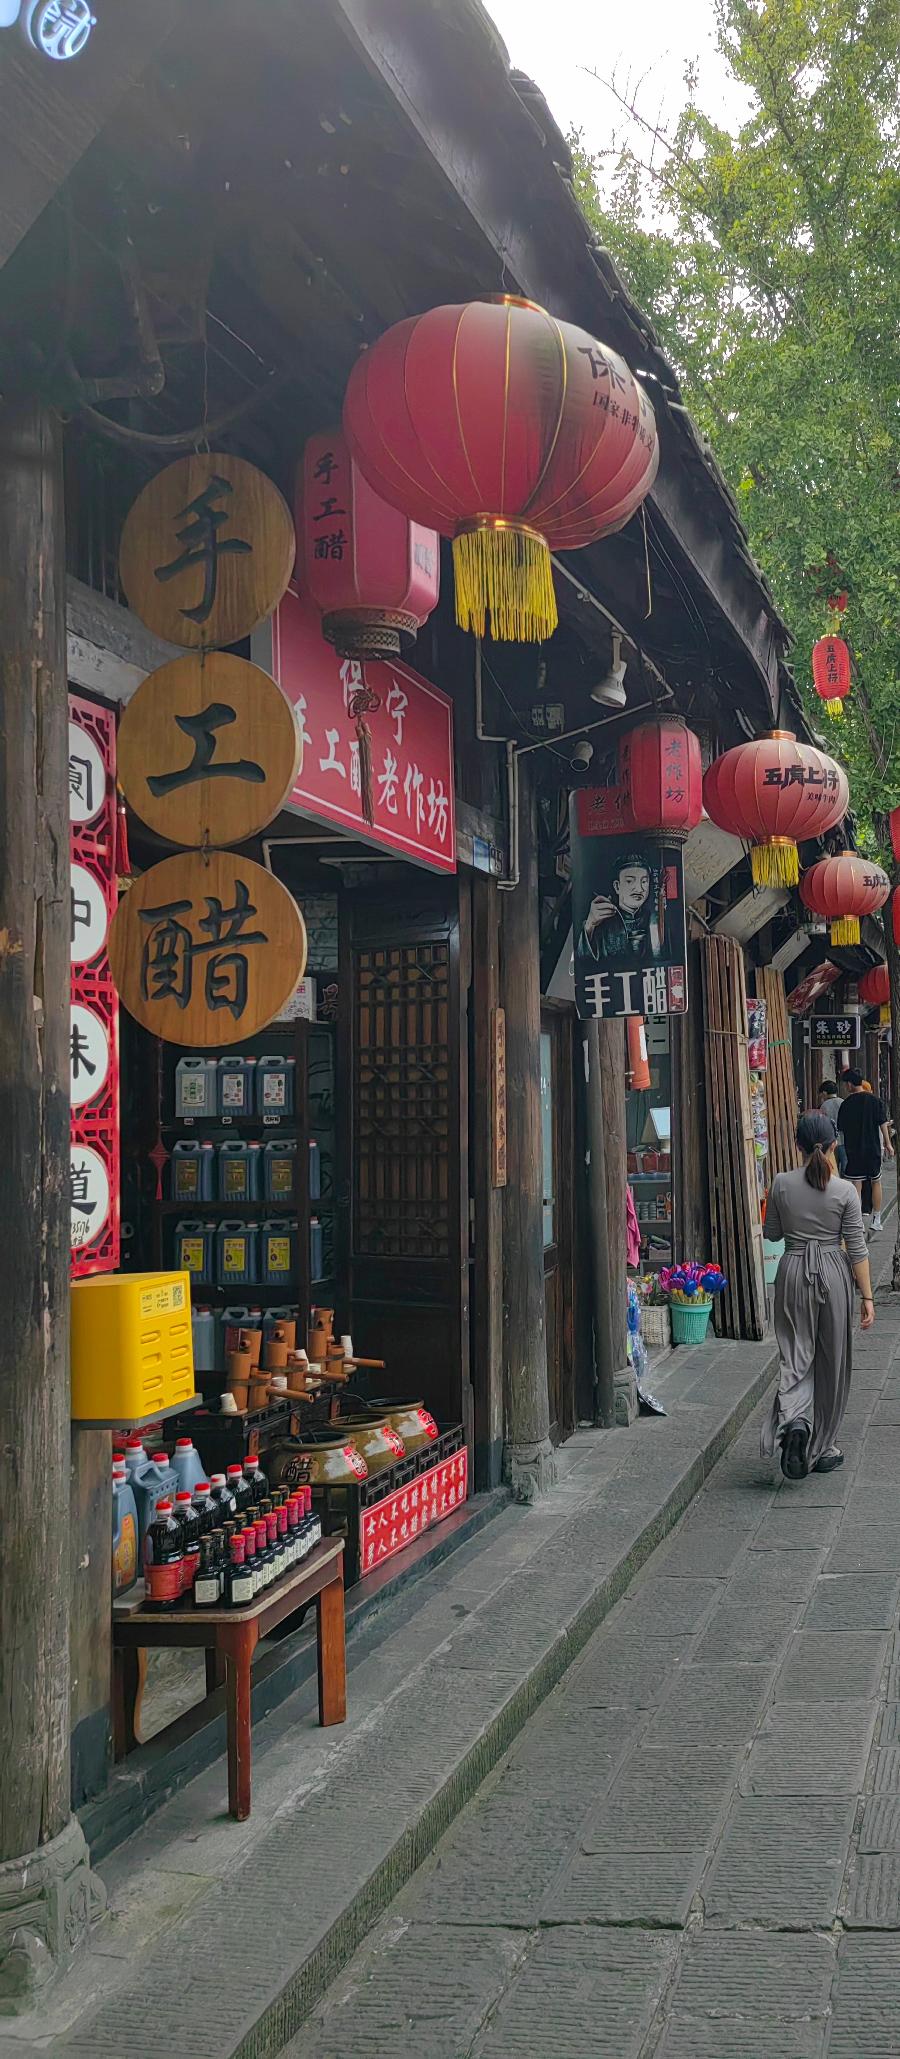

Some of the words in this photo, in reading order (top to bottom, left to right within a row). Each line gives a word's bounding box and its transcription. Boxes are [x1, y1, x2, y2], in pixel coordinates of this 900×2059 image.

[313, 452, 348, 560] 手工醋
[138, 475, 268, 1021] 手工醋
[665, 740, 685, 803] 老作坊
[762, 765, 840, 790] 五虎上将
[585, 966, 668, 1018] 手工醋
[816, 1020, 852, 1035] 朱砂
